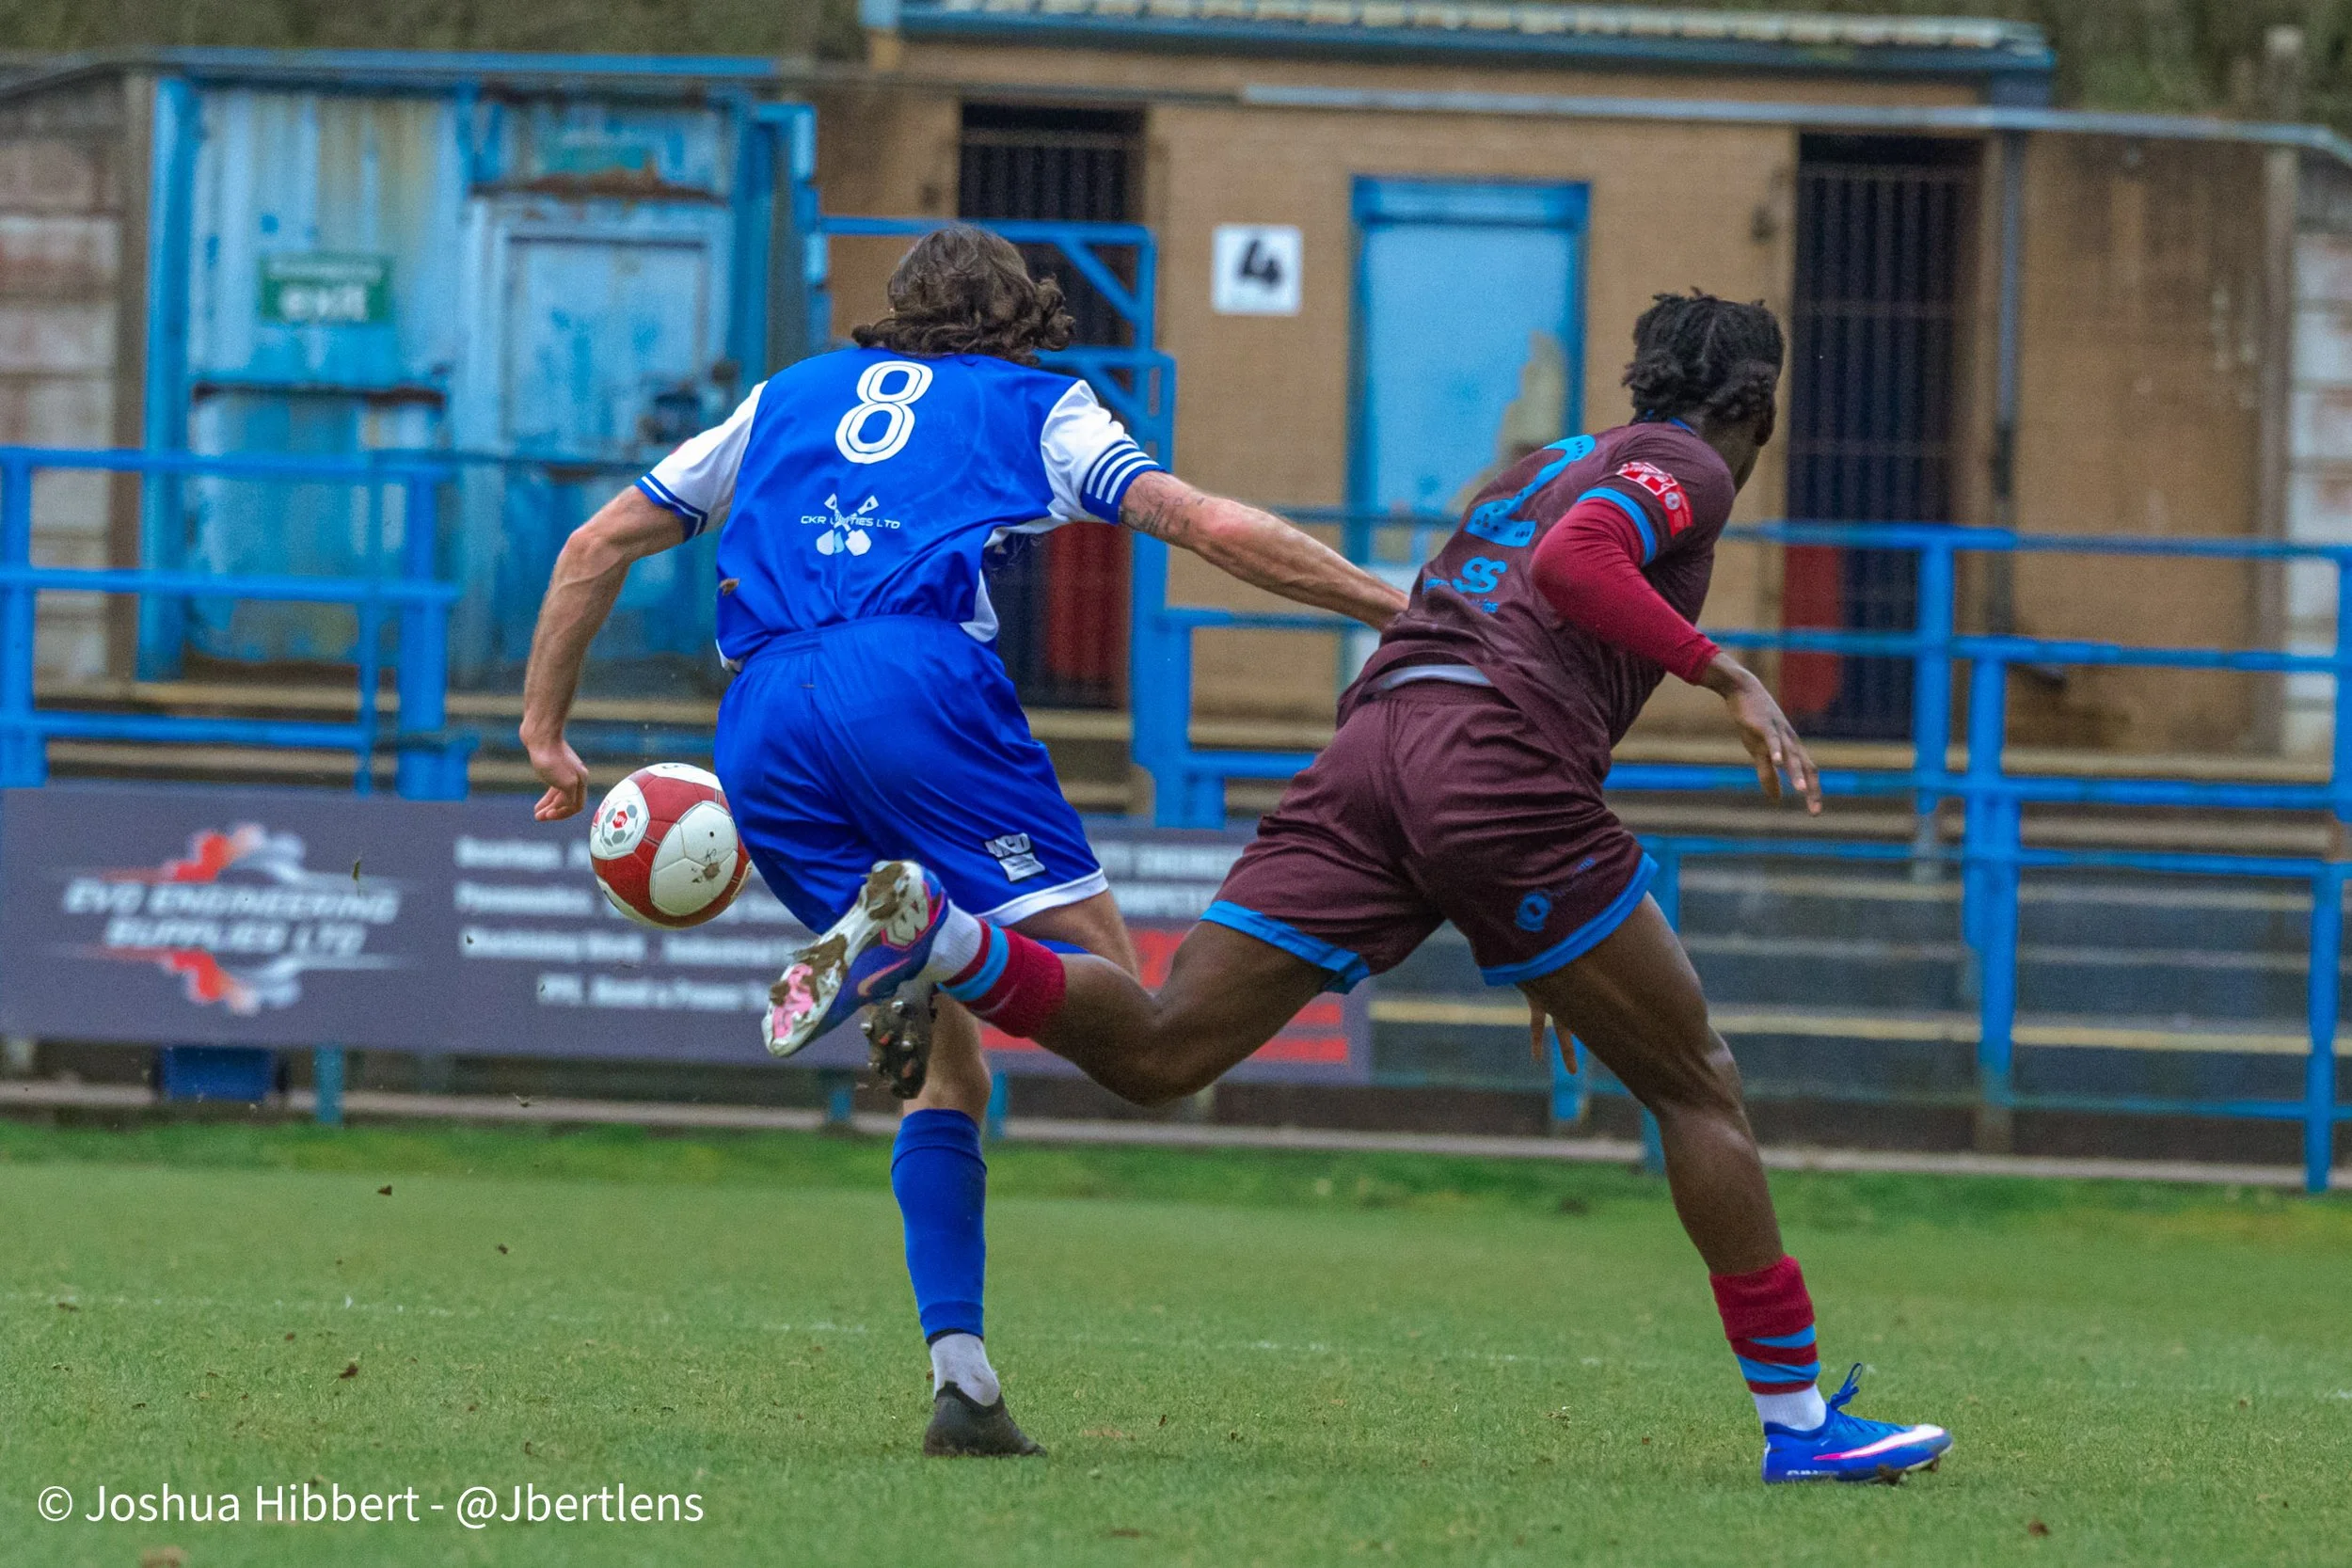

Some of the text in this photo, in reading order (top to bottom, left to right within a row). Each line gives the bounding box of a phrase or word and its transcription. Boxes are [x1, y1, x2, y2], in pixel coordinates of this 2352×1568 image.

[1235, 238, 1284, 290] 4
[835, 360, 933, 464] 8
[1463, 434, 1597, 547] 2
[800, 515, 827, 525] CKR
[876, 518, 901, 530] LTD
[148, 882, 399, 923] ENGINEERING
[294, 922, 368, 955] LTD
